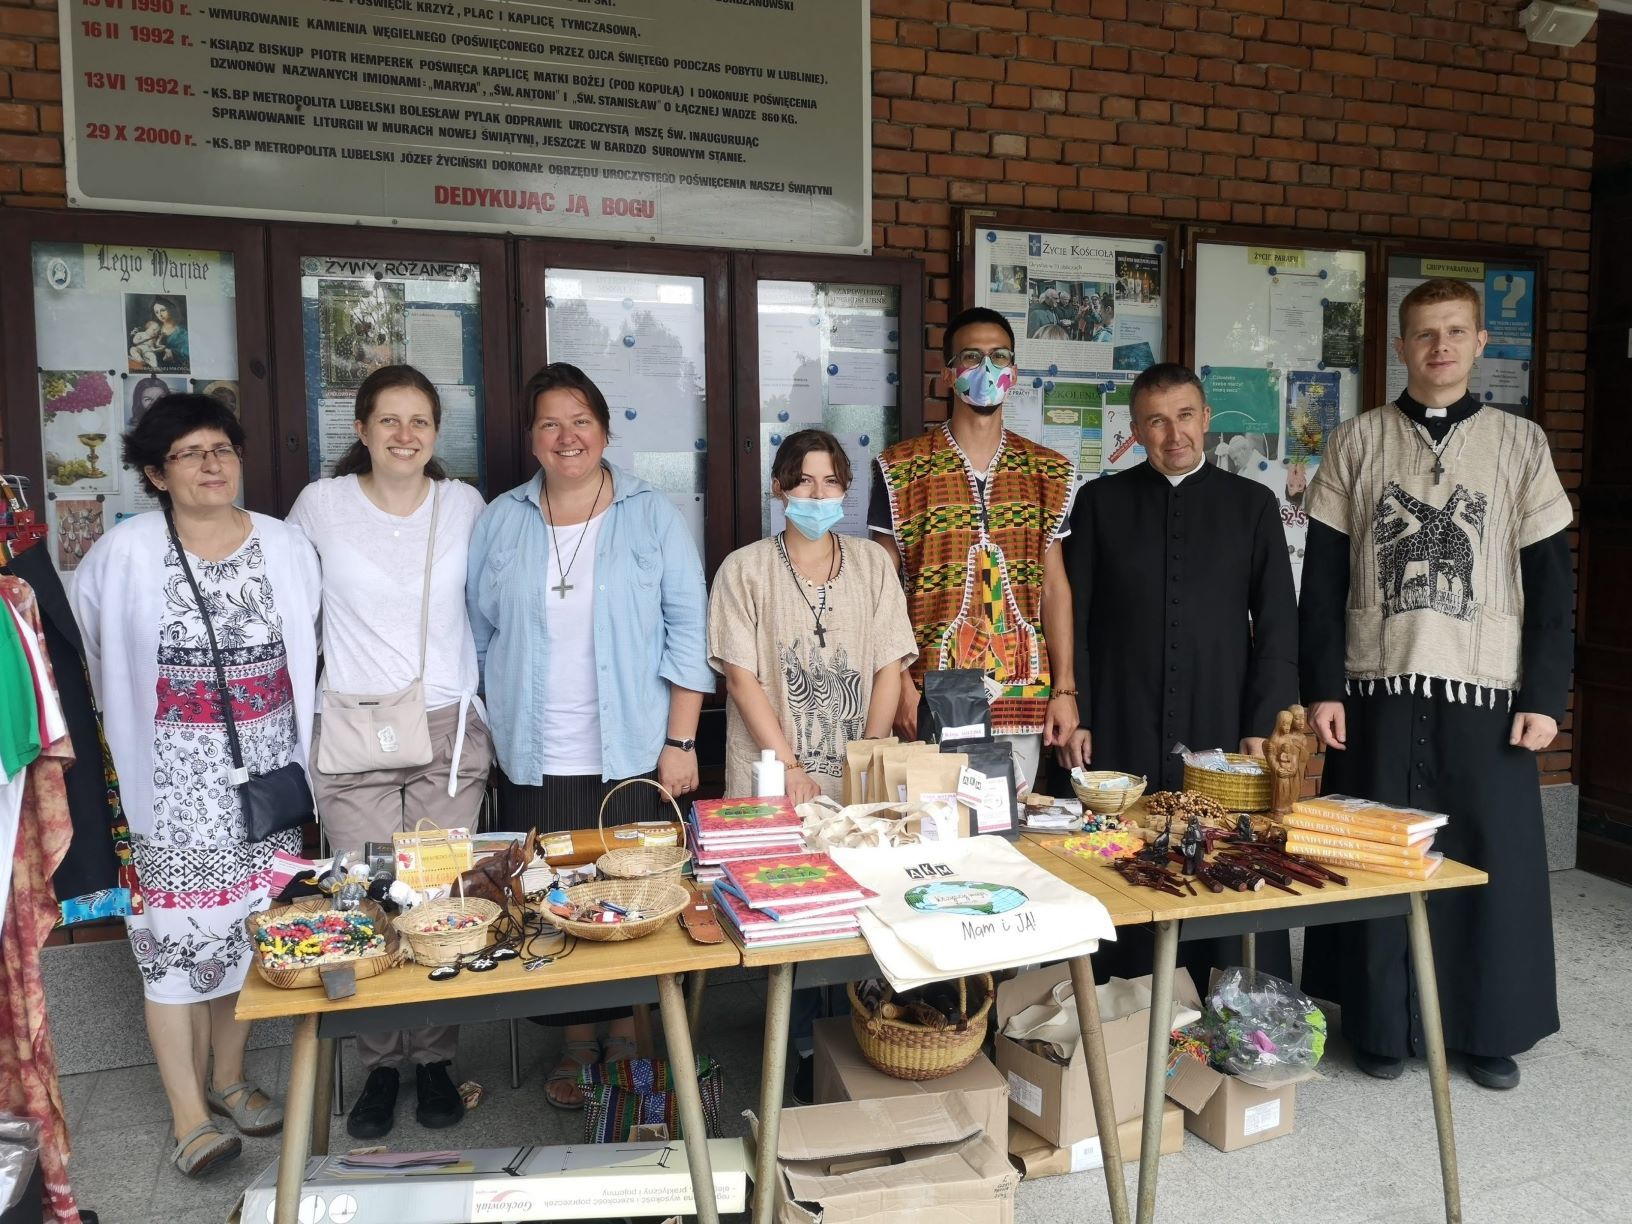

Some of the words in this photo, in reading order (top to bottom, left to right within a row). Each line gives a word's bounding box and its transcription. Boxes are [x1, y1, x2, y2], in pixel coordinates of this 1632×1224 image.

[463, 6, 494, 20] PLAC
[508, 12, 554, 29] KAPLICĘ
[560, 18, 641, 38] TYMCZASOWĄ.
[82, 20, 102, 38] 16
[106, 22, 119, 39] II
[130, 25, 175, 45] 1992
[259, 43, 303, 57] BISKUP
[310, 49, 346, 62] PIOTR
[350, 52, 413, 69] HEMPEREK
[419, 59, 478, 75] POŚWIĘCA
[483, 66, 529, 81] KAPLICĘ
[534, 71, 568, 84] MATKI
[572, 75, 605, 88] BOŻEJ
[609, 77, 635, 91] (POD
[638, 82, 684, 97] KOPUŁĄ)
[698, 88, 749, 103] DOKONUJE
[753, 93, 817, 109] POŚWIĘCENIA
[307, 18, 367, 35] KAMIENIA
[372, 25, 446, 44] WĘGIELNEGO
[451, 33, 544, 54] (POŚWIĘCONEGO
[549, 44, 584, 59] PRZEZ
[588, 48, 614, 61] OJCA
[618, 51, 669, 68] ŚWIĘTEGO
[673, 58, 721, 73] PODCZAS
[724, 64, 763, 78] POBYTU
[766, 69, 776, 79] W
[778, 70, 828, 85] LUBLINIE).
[84, 71, 104, 88] 13
[106, 73, 125, 90] VI
[135, 75, 179, 96] 1992
[253, 91, 336, 108] METROPOLITA
[340, 99, 395, 114] LUBELSKI
[400, 104, 460, 120] BOLESŁAW
[464, 111, 500, 124] PYLAK
[505, 114, 563, 129] ODPRAWIŁ
[568, 119, 629, 137] UROCZYSTĄ
[634, 126, 664, 141] MSZĘ
[667, 128, 687, 140] ŚW.
[689, 131, 759, 148] INAUGURUJĄC
[282, 64, 358, 82] NAZWANYCH
[663, 102, 670, 112] O
[675, 103, 719, 118] ŁĄCZNEJ
[722, 107, 757, 121] WADZE
[761, 112, 780, 123] 860
[781, 113, 798, 125] KG.
[212, 106, 305, 125] SPRAWOWANIE
[313, 116, 363, 131] LITURGII
[367, 121, 378, 132] W
[382, 122, 433, 137] MURACH
[438, 126, 477, 140] NOWEJ
[481, 128, 539, 147] ŚWIĄTYNI,
[541, 135, 586, 150] JESZCZE
[590, 140, 600, 150] W
[604, 140, 647, 154] BARDZO
[652, 145, 705, 160] SUROWYM
[708, 150, 746, 163] STANIE.
[86, 122, 110, 140] 29
[114, 124, 127, 141] X
[134, 125, 181, 146] 2000
[254, 140, 337, 158] METROPOLITA
[341, 147, 394, 163] LUBELSKI
[400, 150, 433, 165] JÓZEF
[436, 153, 487, 170] ŻYCIŃSKI
[491, 159, 544, 174] DOKONAŁ
[548, 163, 598, 180] OBRZĘDU
[602, 168, 676, 184] UROCZYSTEGO
[679, 172, 747, 190] POŚWIĘCENIA
[749, 179, 785, 192] NASZEJ
[788, 180, 832, 196] ŚWIĄTYNI
[434, 185, 555, 213] DEDYKUJĄC
[565, 194, 590, 217] JĄ
[601, 196, 655, 218] BOGU
[98, 244, 142, 282] Legio
[905, 863, 954, 879] AKM
[961, 921, 995, 940] Mam
[1002, 919, 1010, 931] i
[1015, 911, 1036, 933] JA!
[475, 1201, 533, 1213] Gockowiak
